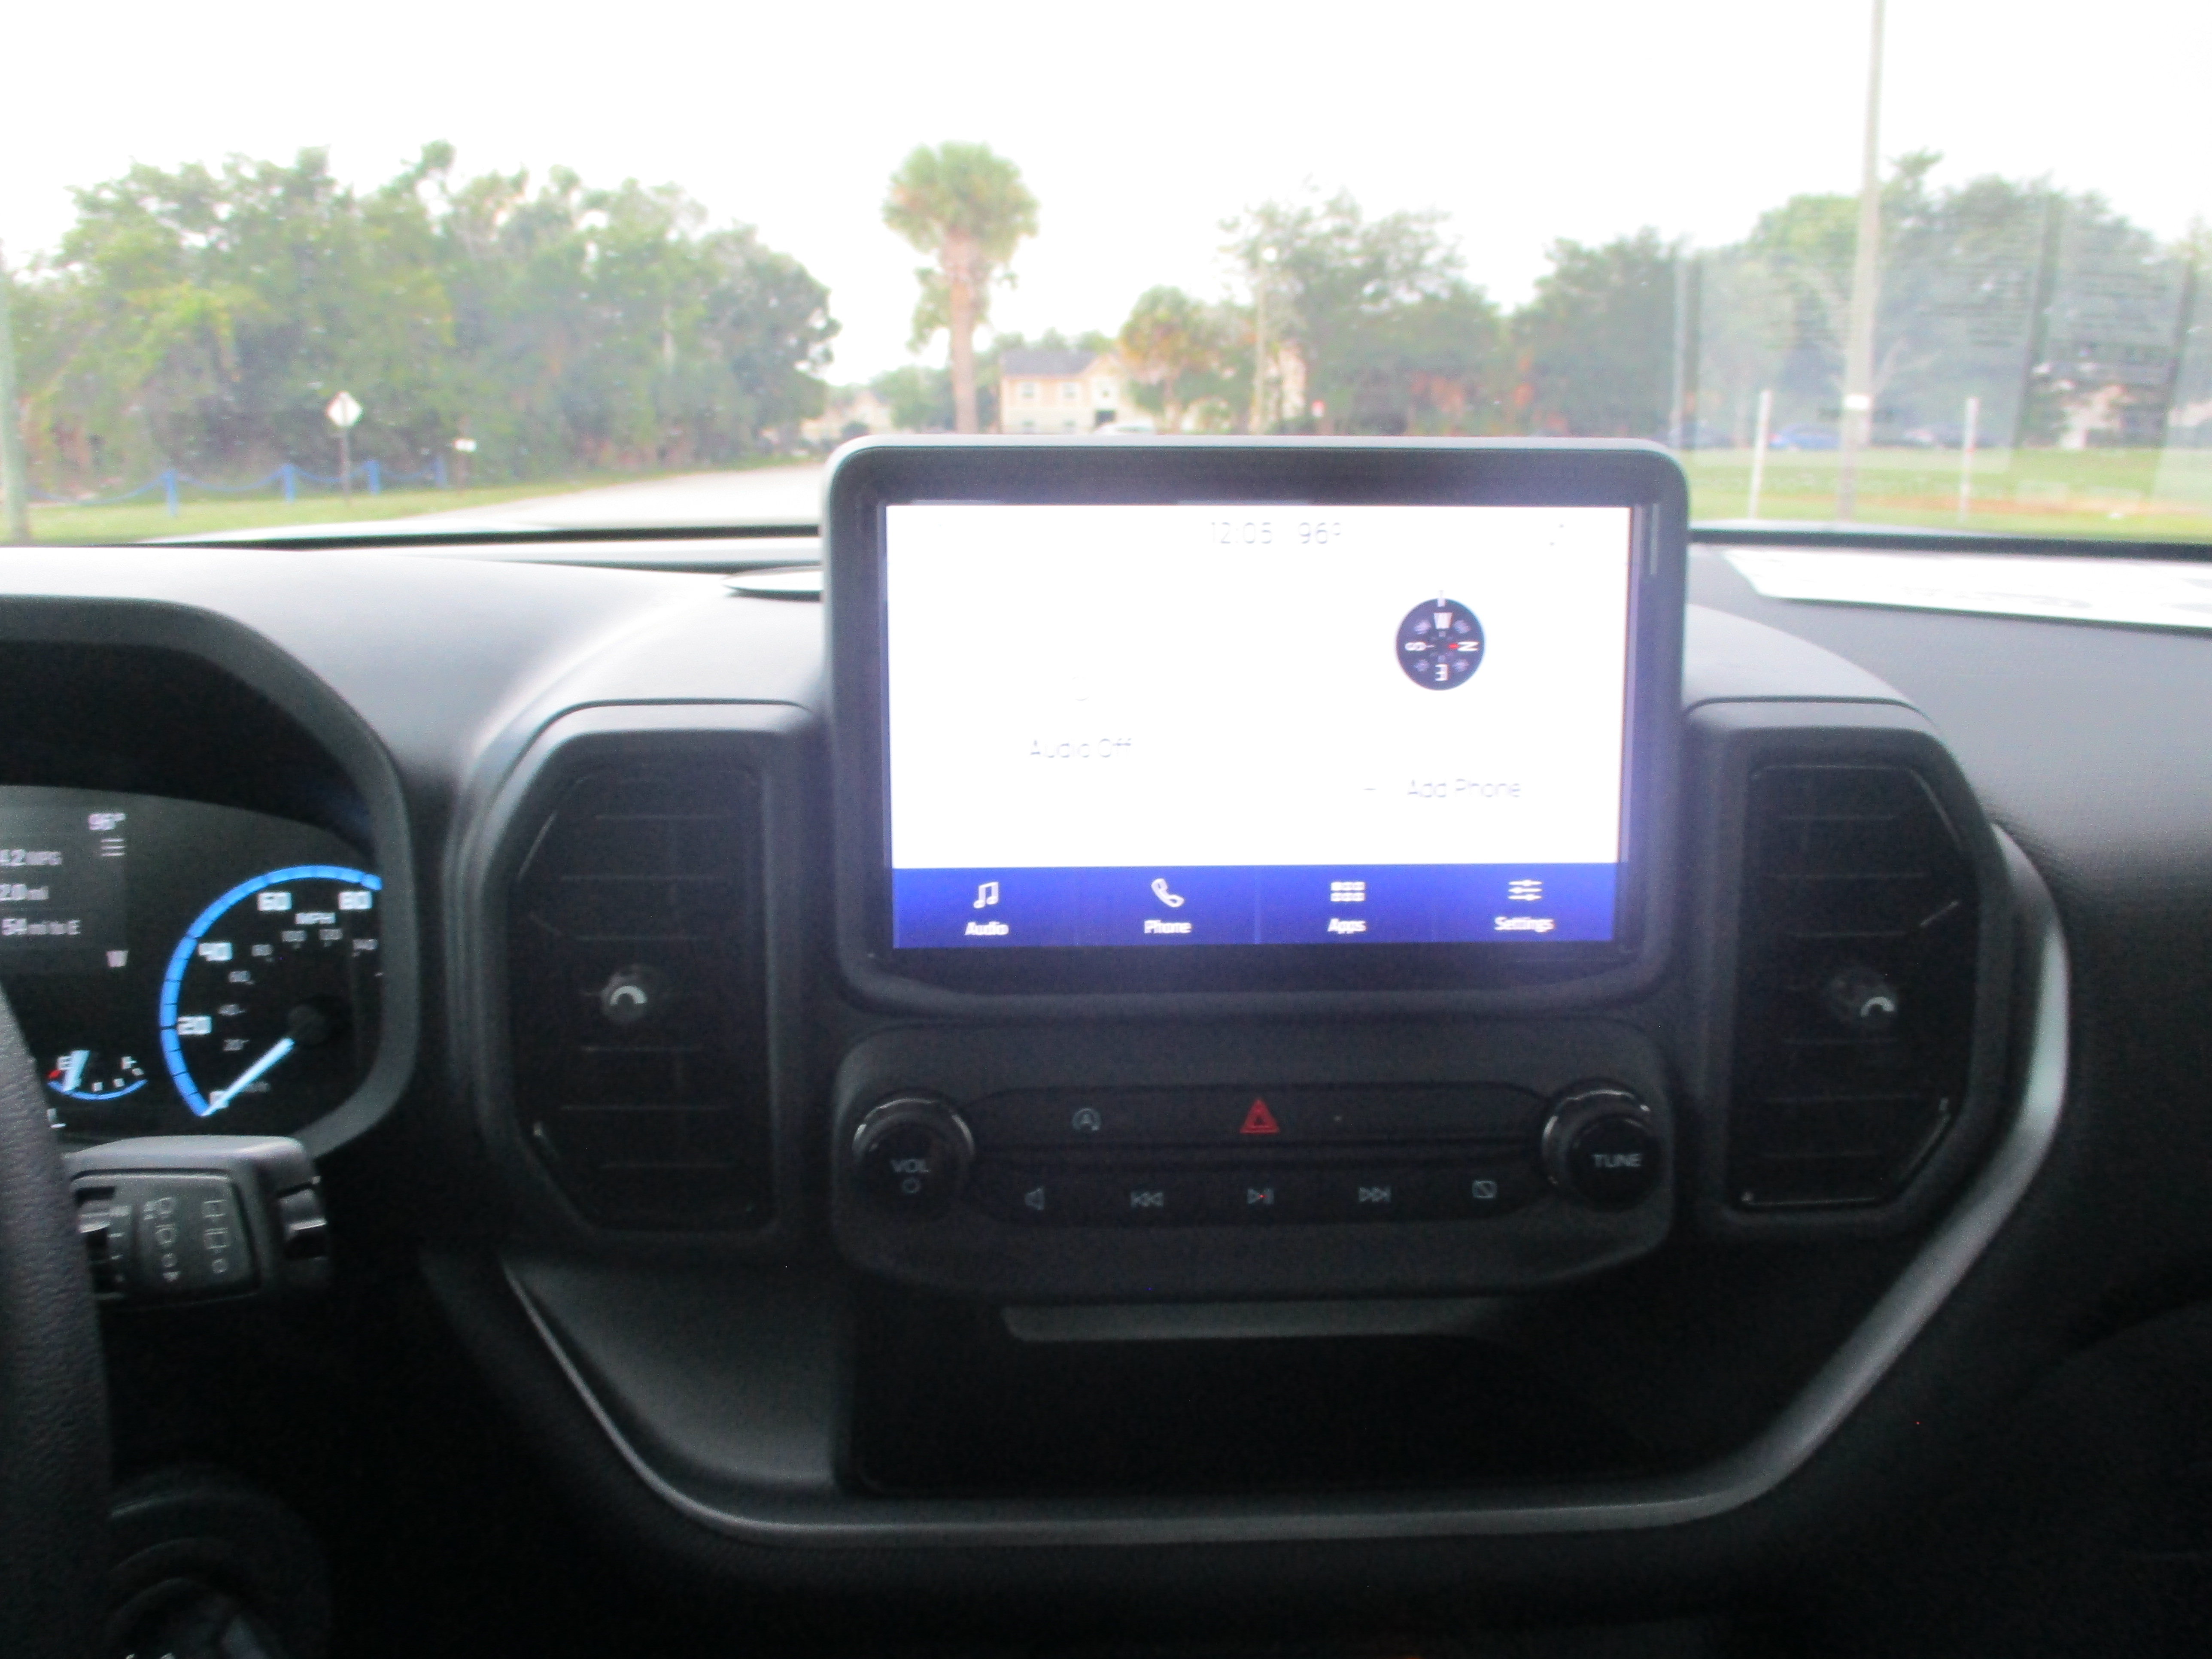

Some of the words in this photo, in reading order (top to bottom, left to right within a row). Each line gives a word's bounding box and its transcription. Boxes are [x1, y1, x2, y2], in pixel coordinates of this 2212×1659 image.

[1211, 522, 1272, 544] 12:05
[1297, 522, 1341, 544] 96°
[1457, 641, 1480, 652] N
[1434, 663, 1449, 681] E
[1455, 778, 1522, 798] Phone
[258, 891, 292, 911] 60
[964, 921, 1009, 936] Audio
[1143, 919, 1192, 934] Phone
[1328, 918, 1367, 934] Apps
[1494, 916, 1556, 933] Settings
[198, 942, 233, 961] 40
[177, 1015, 213, 1036] 20
[890, 1158, 930, 1173] VOL
[1592, 1153, 1642, 1168] TUNE
